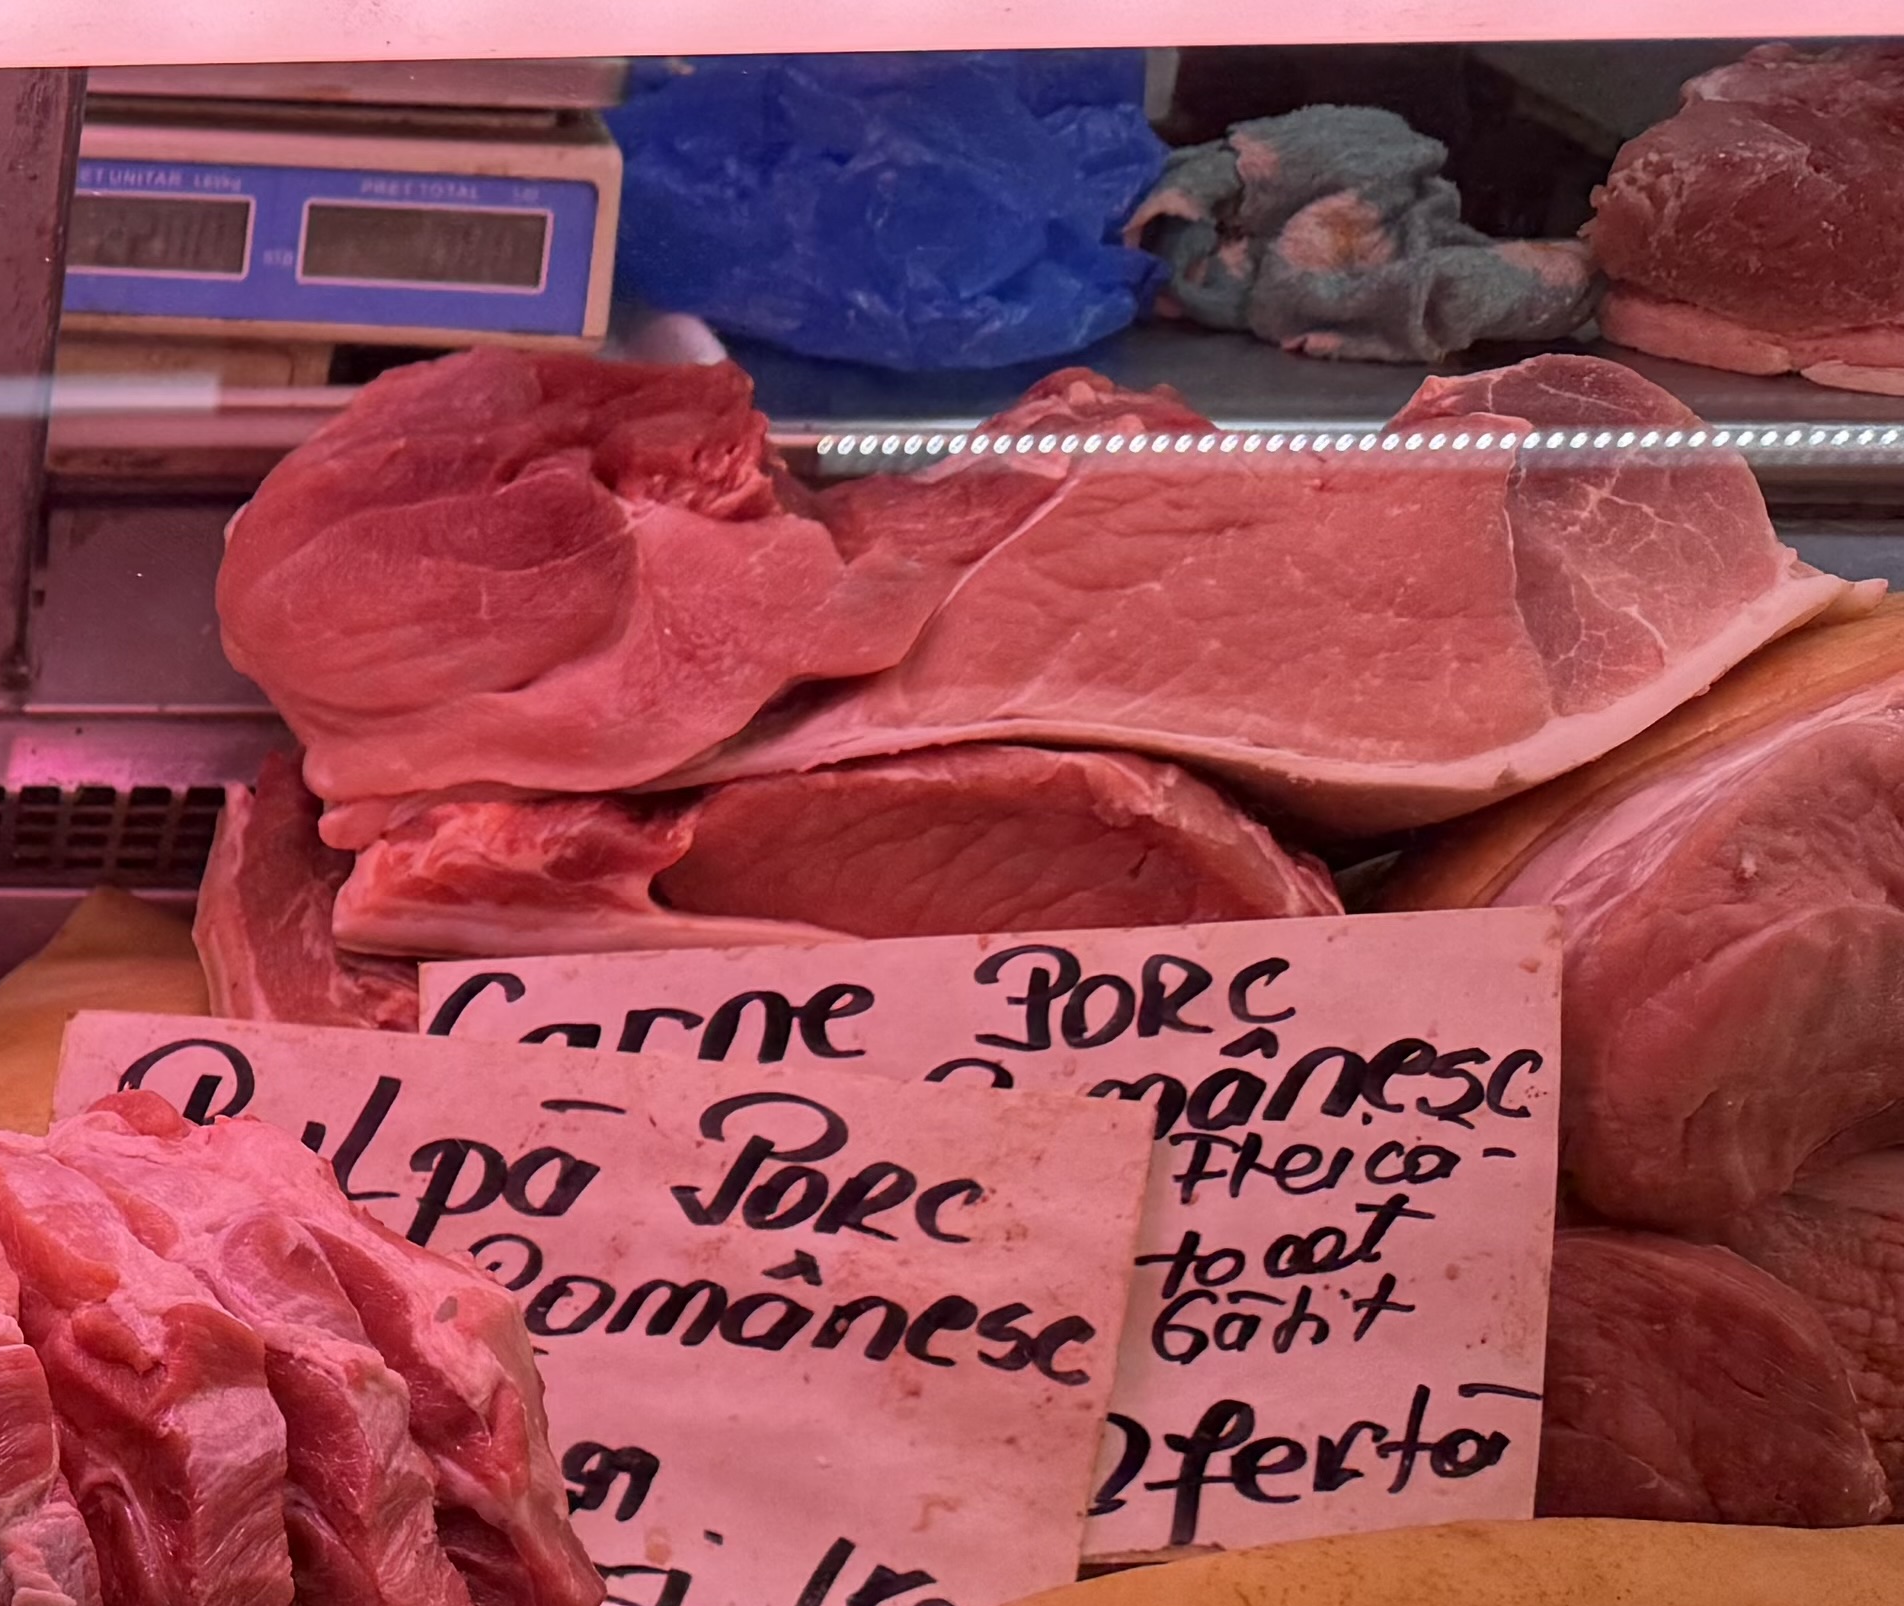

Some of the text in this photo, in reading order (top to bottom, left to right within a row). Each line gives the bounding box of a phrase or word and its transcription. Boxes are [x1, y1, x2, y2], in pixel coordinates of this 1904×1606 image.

[108, 168, 182, 187] UNITAR
[420, 181, 479, 199] TOTAL
[117, 1038, 627, 1247] Plpă
